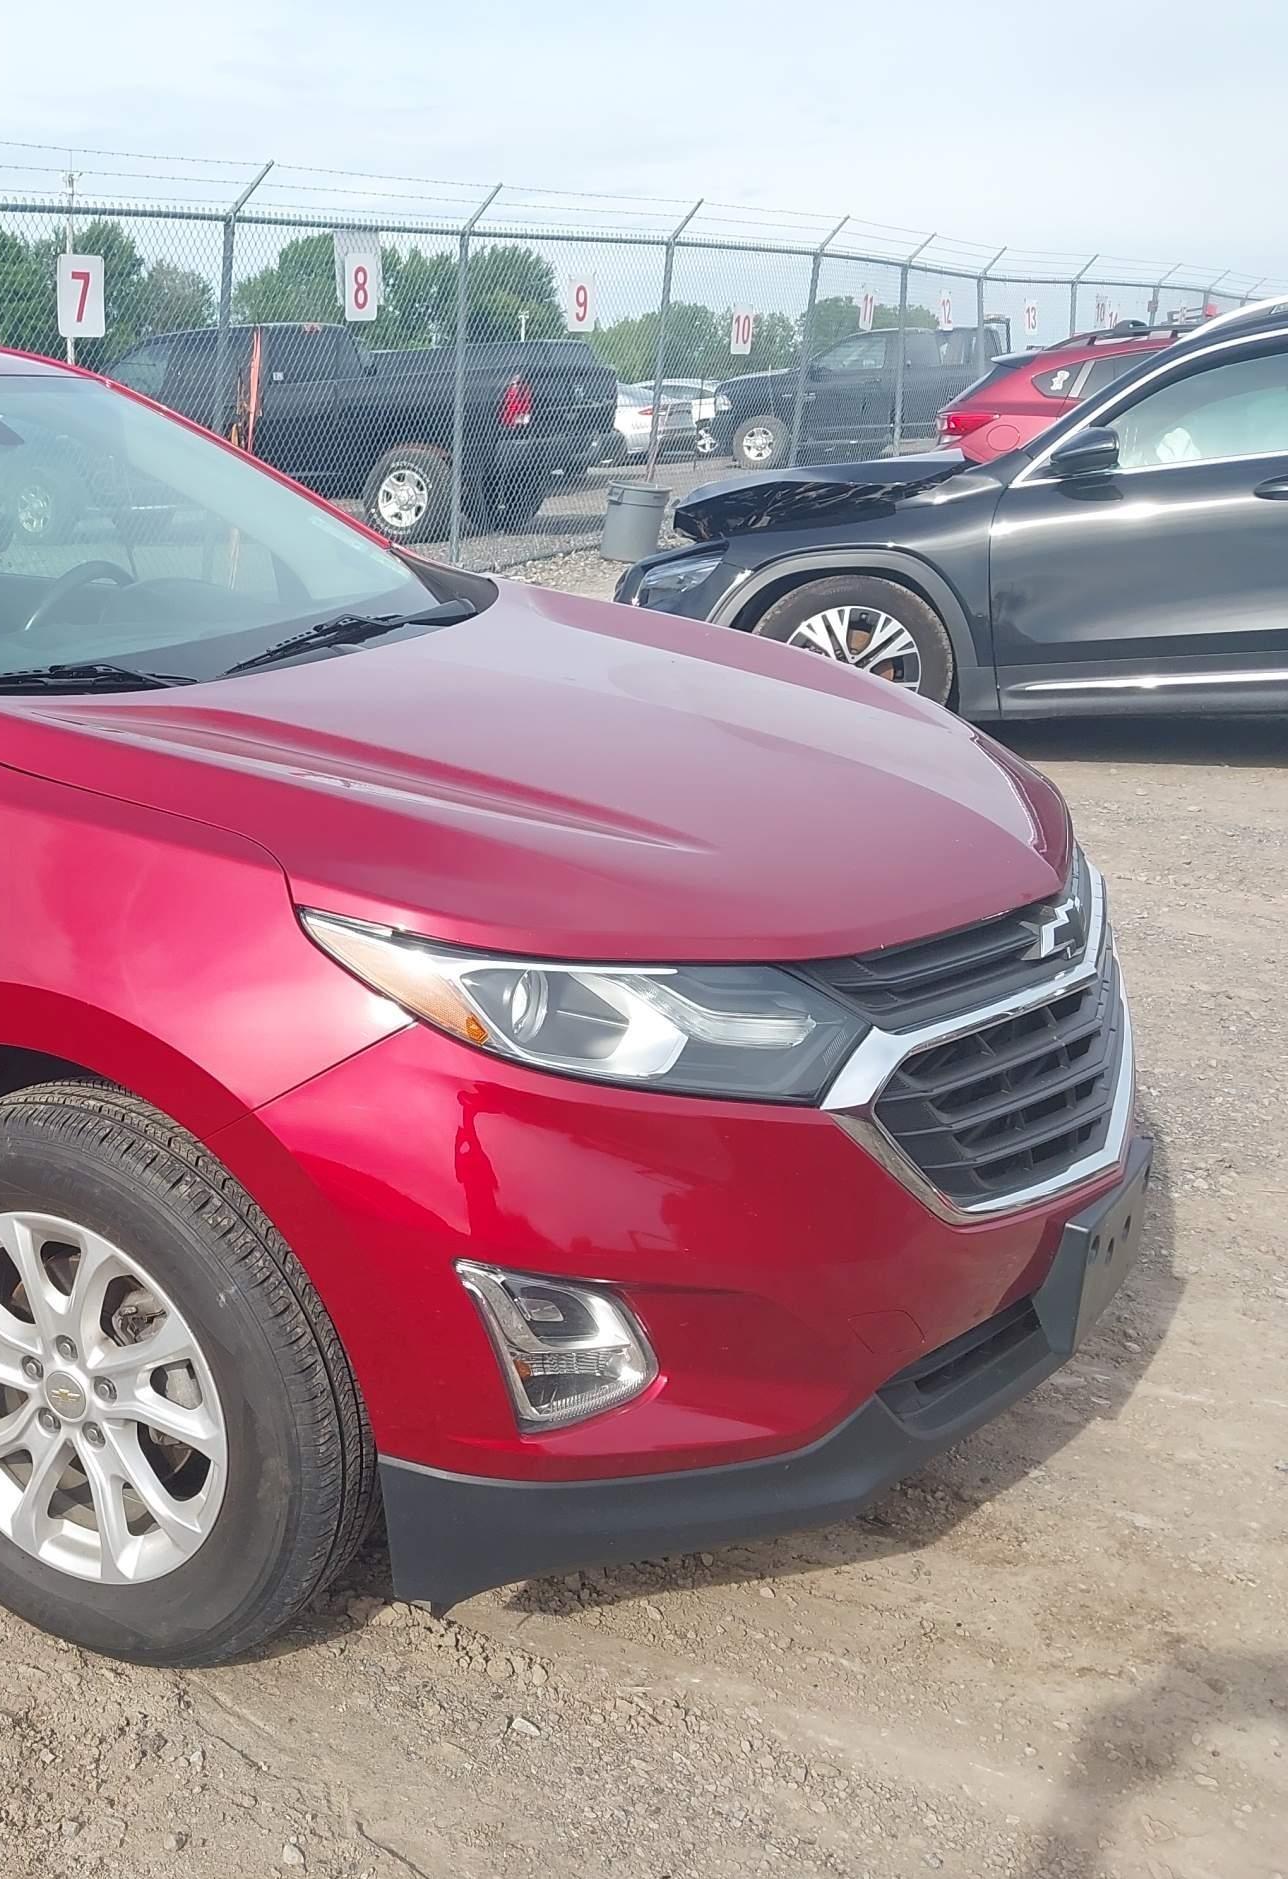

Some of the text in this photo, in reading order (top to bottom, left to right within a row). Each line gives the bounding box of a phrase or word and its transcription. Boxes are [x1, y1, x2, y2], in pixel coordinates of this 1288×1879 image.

[71, 271, 90, 322] 7
[354, 266, 368, 310] 8
[576, 285, 588, 322] 9
[864, 294, 874, 325] 11
[941, 299, 952, 325] 12
[1025, 306, 1037, 330] 13
[735, 315, 751, 345] 10
